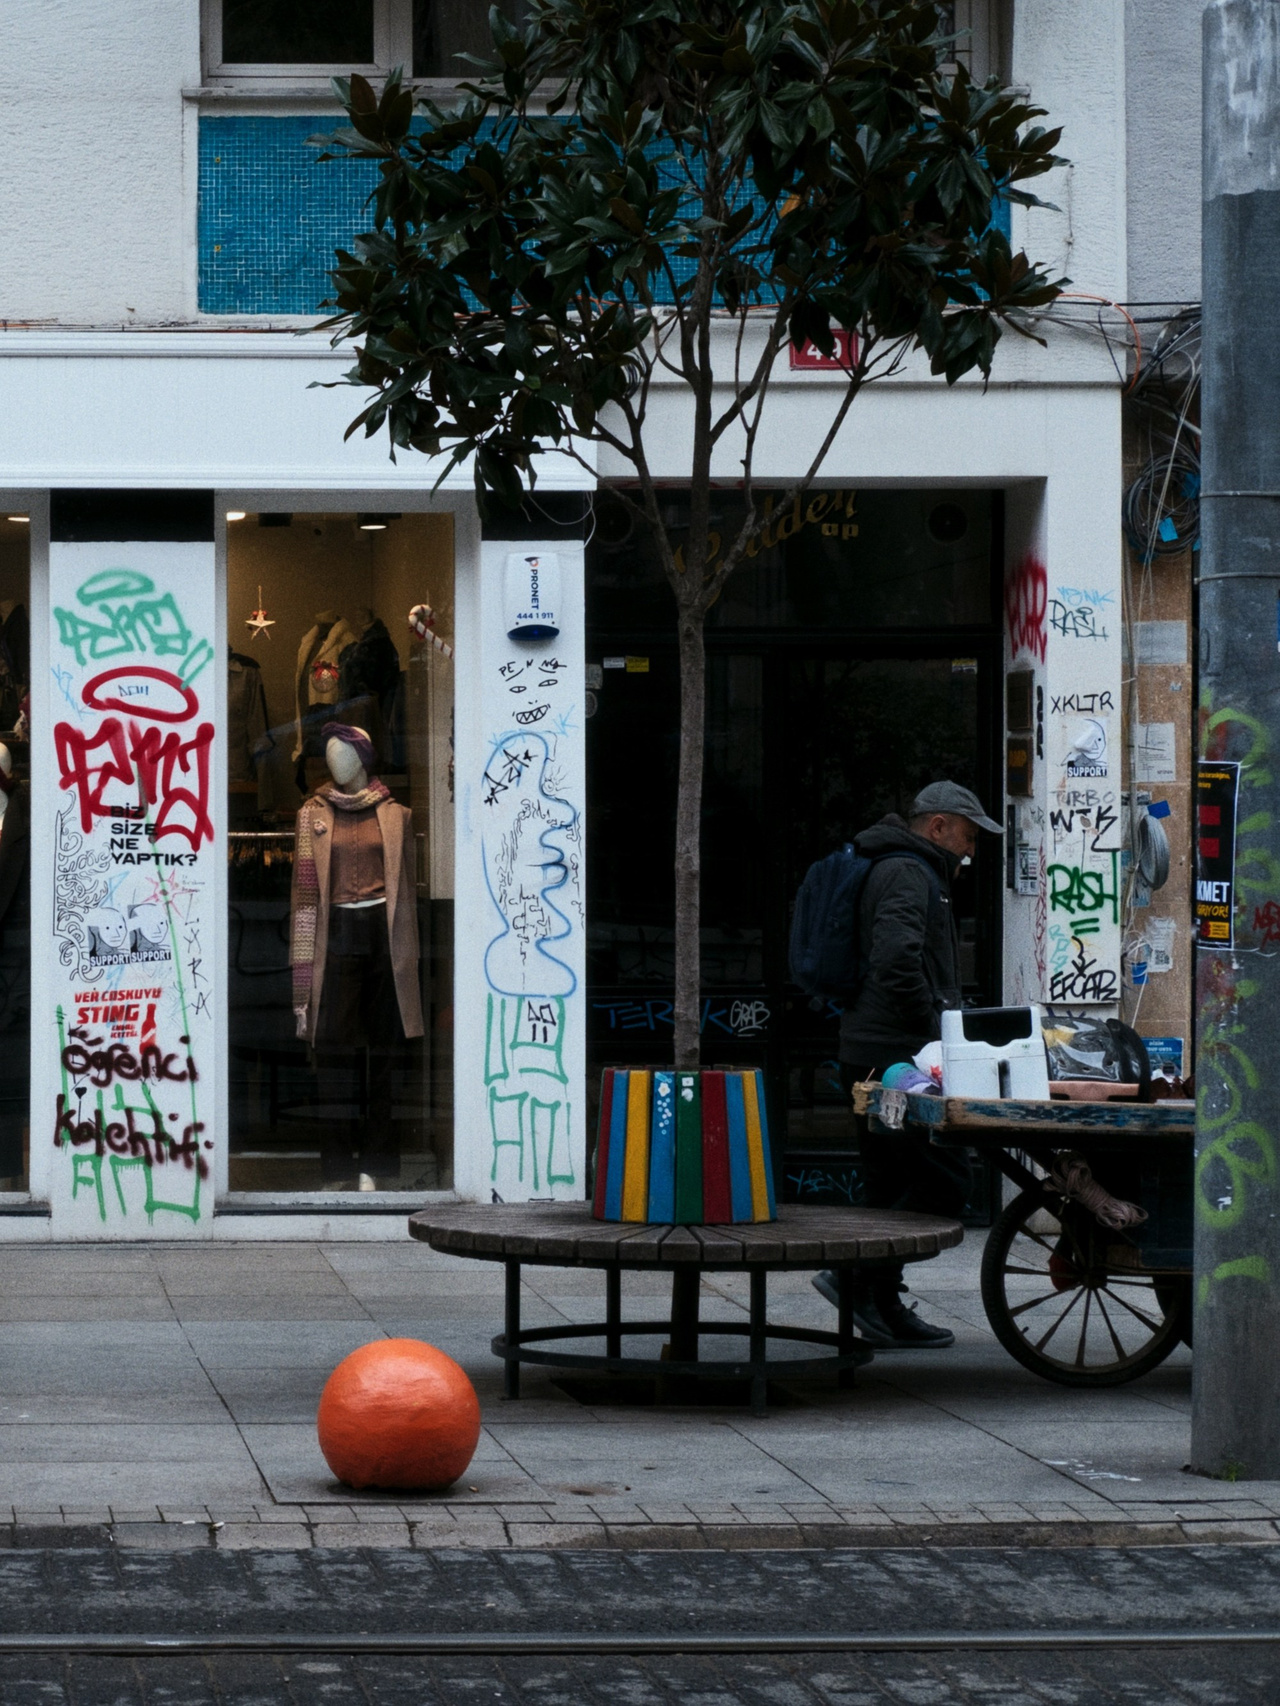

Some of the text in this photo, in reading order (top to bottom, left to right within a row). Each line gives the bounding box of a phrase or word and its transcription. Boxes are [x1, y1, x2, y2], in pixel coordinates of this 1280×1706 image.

[530, 568, 540, 611] PRONET
[1067, 765, 1108, 778] SUPPORT
[110, 803, 145, 819] BİZ
[111, 820, 158, 836] SİZE
[110, 838, 140, 850] NE
[111, 853, 199, 867] YAPTIK?
[90, 949, 170, 968] SUPPORT SUPPORT
[76, 1003, 140, 1024] STING
